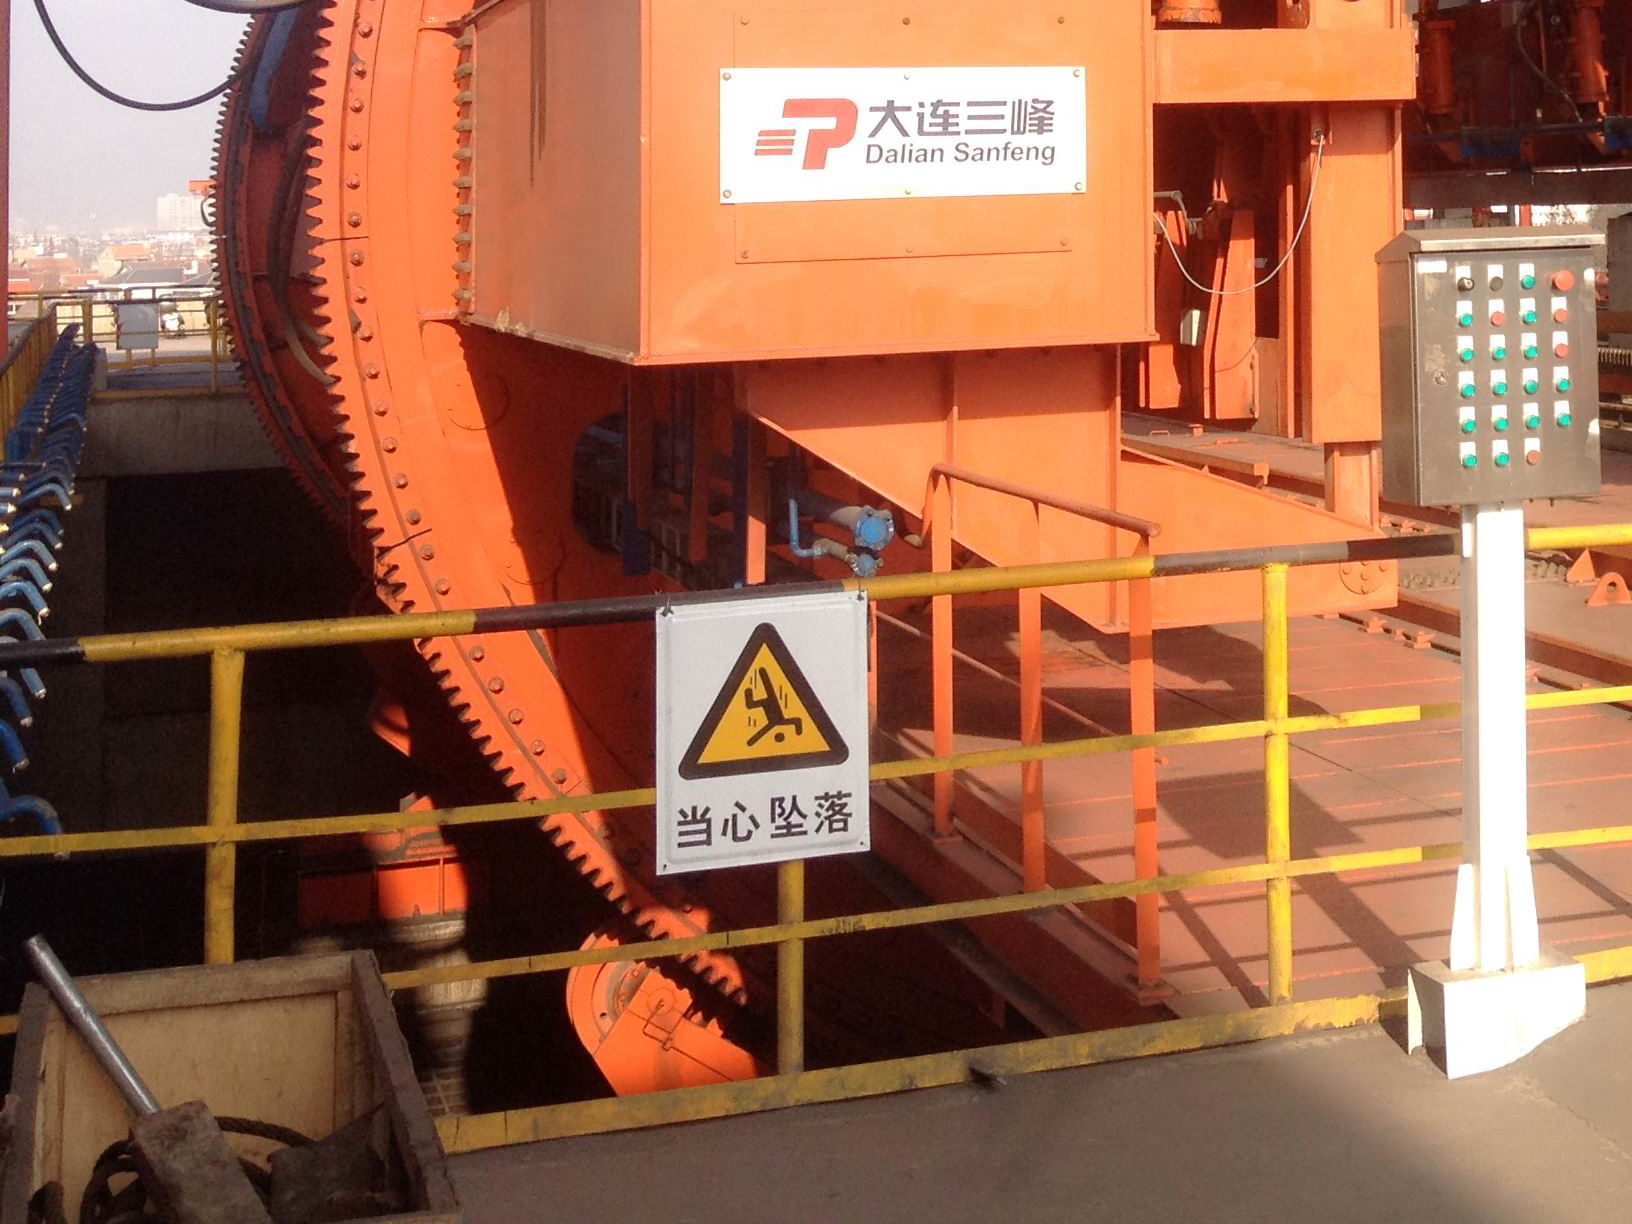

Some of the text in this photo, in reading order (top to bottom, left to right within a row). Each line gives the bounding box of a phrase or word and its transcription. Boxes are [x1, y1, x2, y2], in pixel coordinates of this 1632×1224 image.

[868, 98, 1056, 138] 大连三峰
[865, 140, 1057, 166] Dalian Sanfeng
[677, 790, 853, 849] 当心坠落
